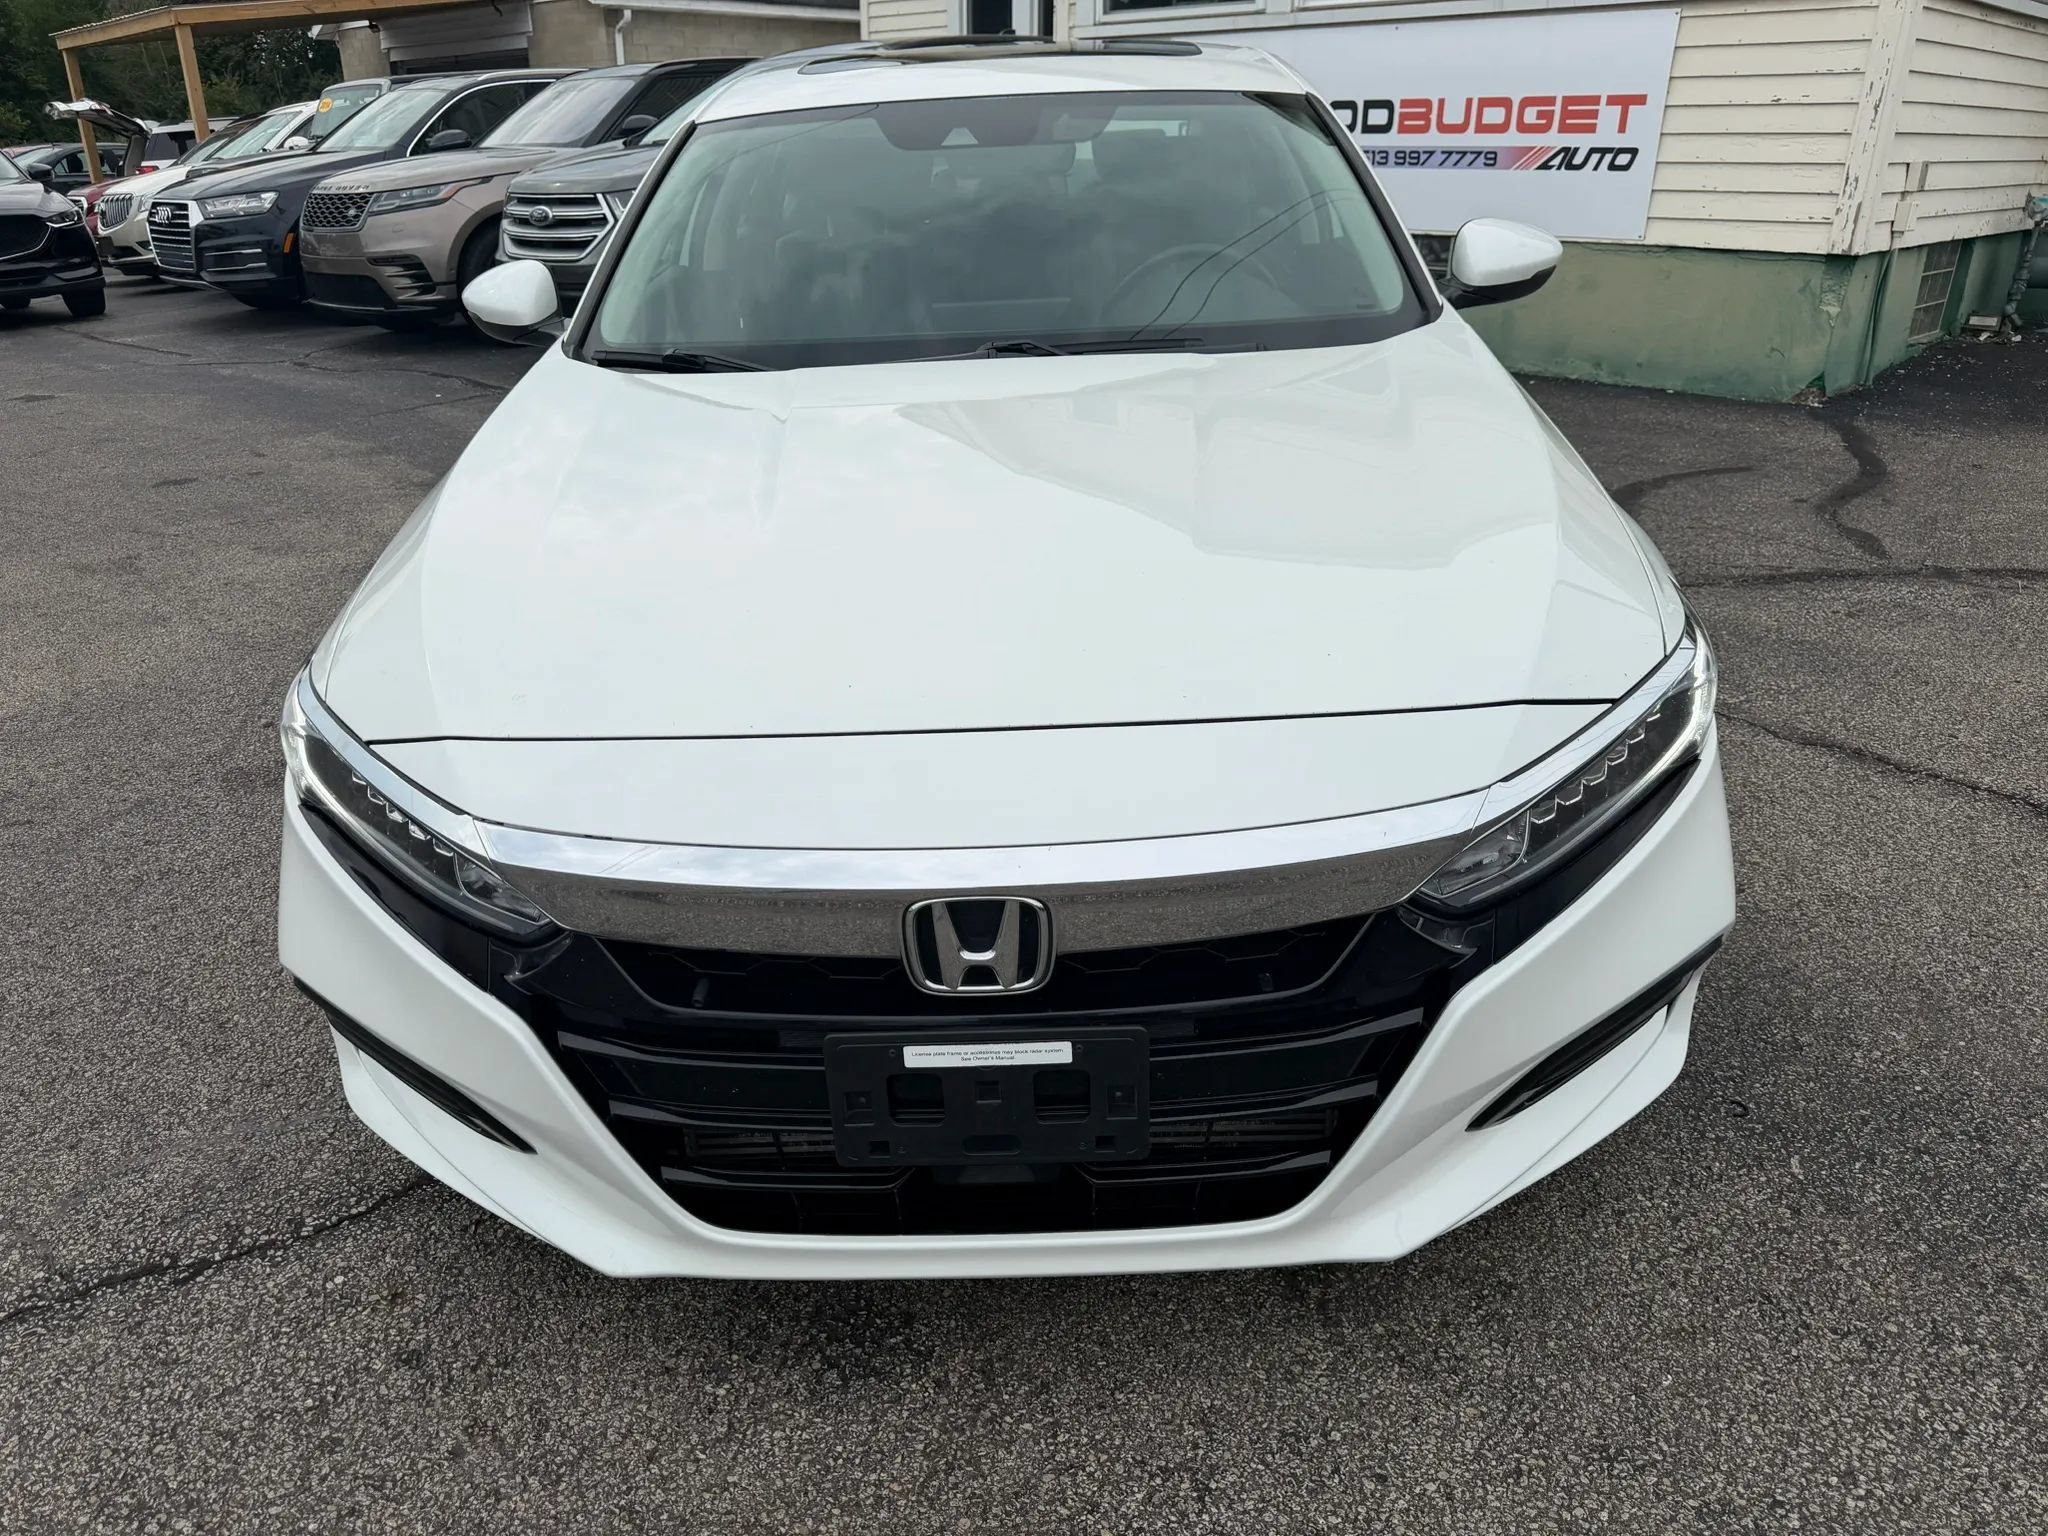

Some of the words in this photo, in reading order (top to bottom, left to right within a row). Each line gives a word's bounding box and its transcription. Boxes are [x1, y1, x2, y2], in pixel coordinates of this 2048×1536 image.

[1394, 150, 1437, 167] 997
[1438, 150, 1498, 167] 7779
[1534, 146, 1639, 171] AUTO
